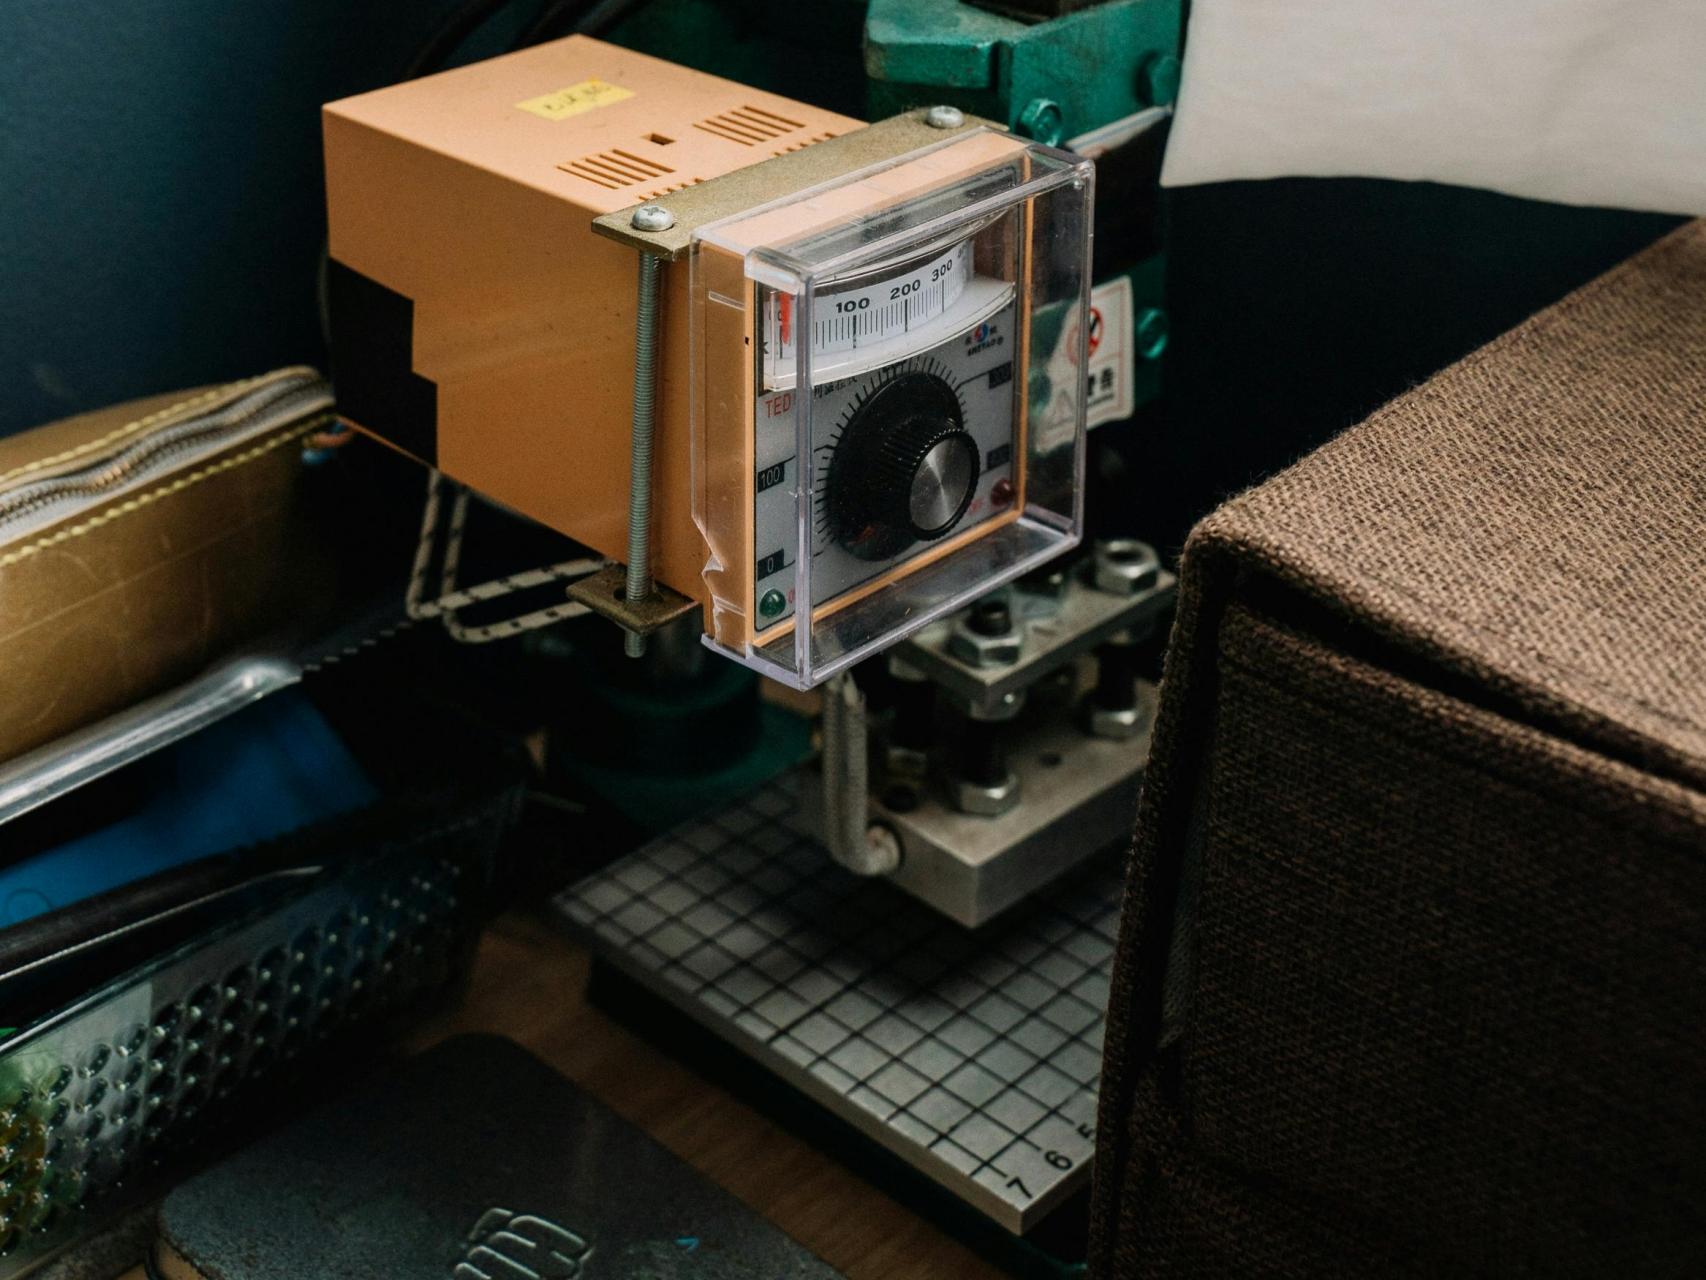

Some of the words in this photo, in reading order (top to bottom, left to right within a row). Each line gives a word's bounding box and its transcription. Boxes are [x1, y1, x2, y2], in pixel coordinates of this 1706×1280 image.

[836, 297, 870, 313] 100
[890, 279, 921, 299] 200
[931, 259, 953, 282] 300
[765, 393, 792, 418] TED
[761, 466, 780, 486] 100
[767, 557, 774, 573] 0
[1006, 1177, 1032, 1199] 7
[1044, 1149, 1073, 1171] 6
